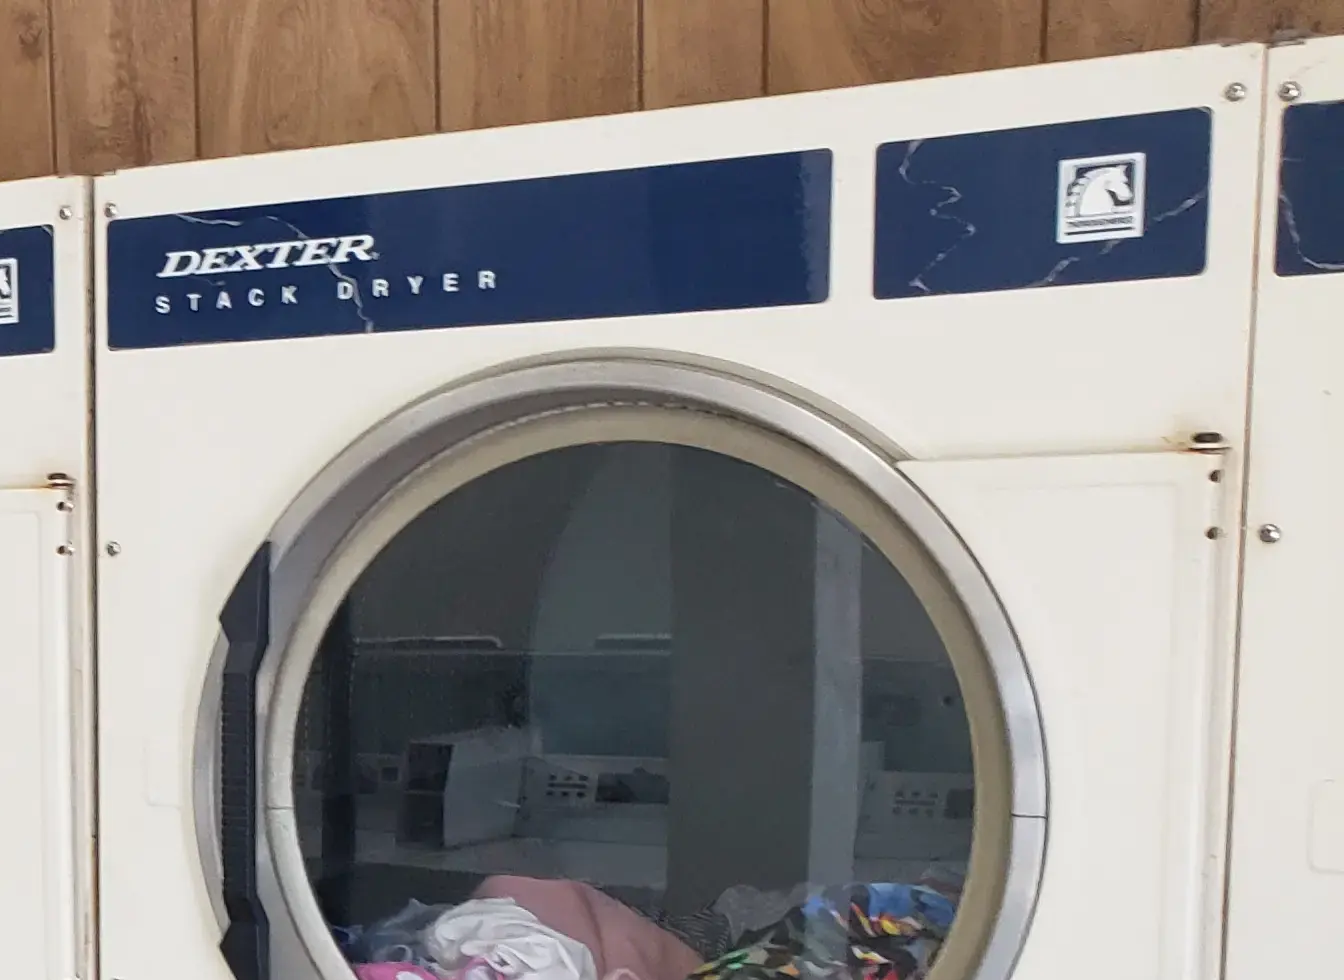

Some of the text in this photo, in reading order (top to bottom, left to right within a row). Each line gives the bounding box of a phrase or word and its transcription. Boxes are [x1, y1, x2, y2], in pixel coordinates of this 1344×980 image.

[155, 234, 375, 280] DEXTER
[154, 269, 498, 315] STACK DRYER
